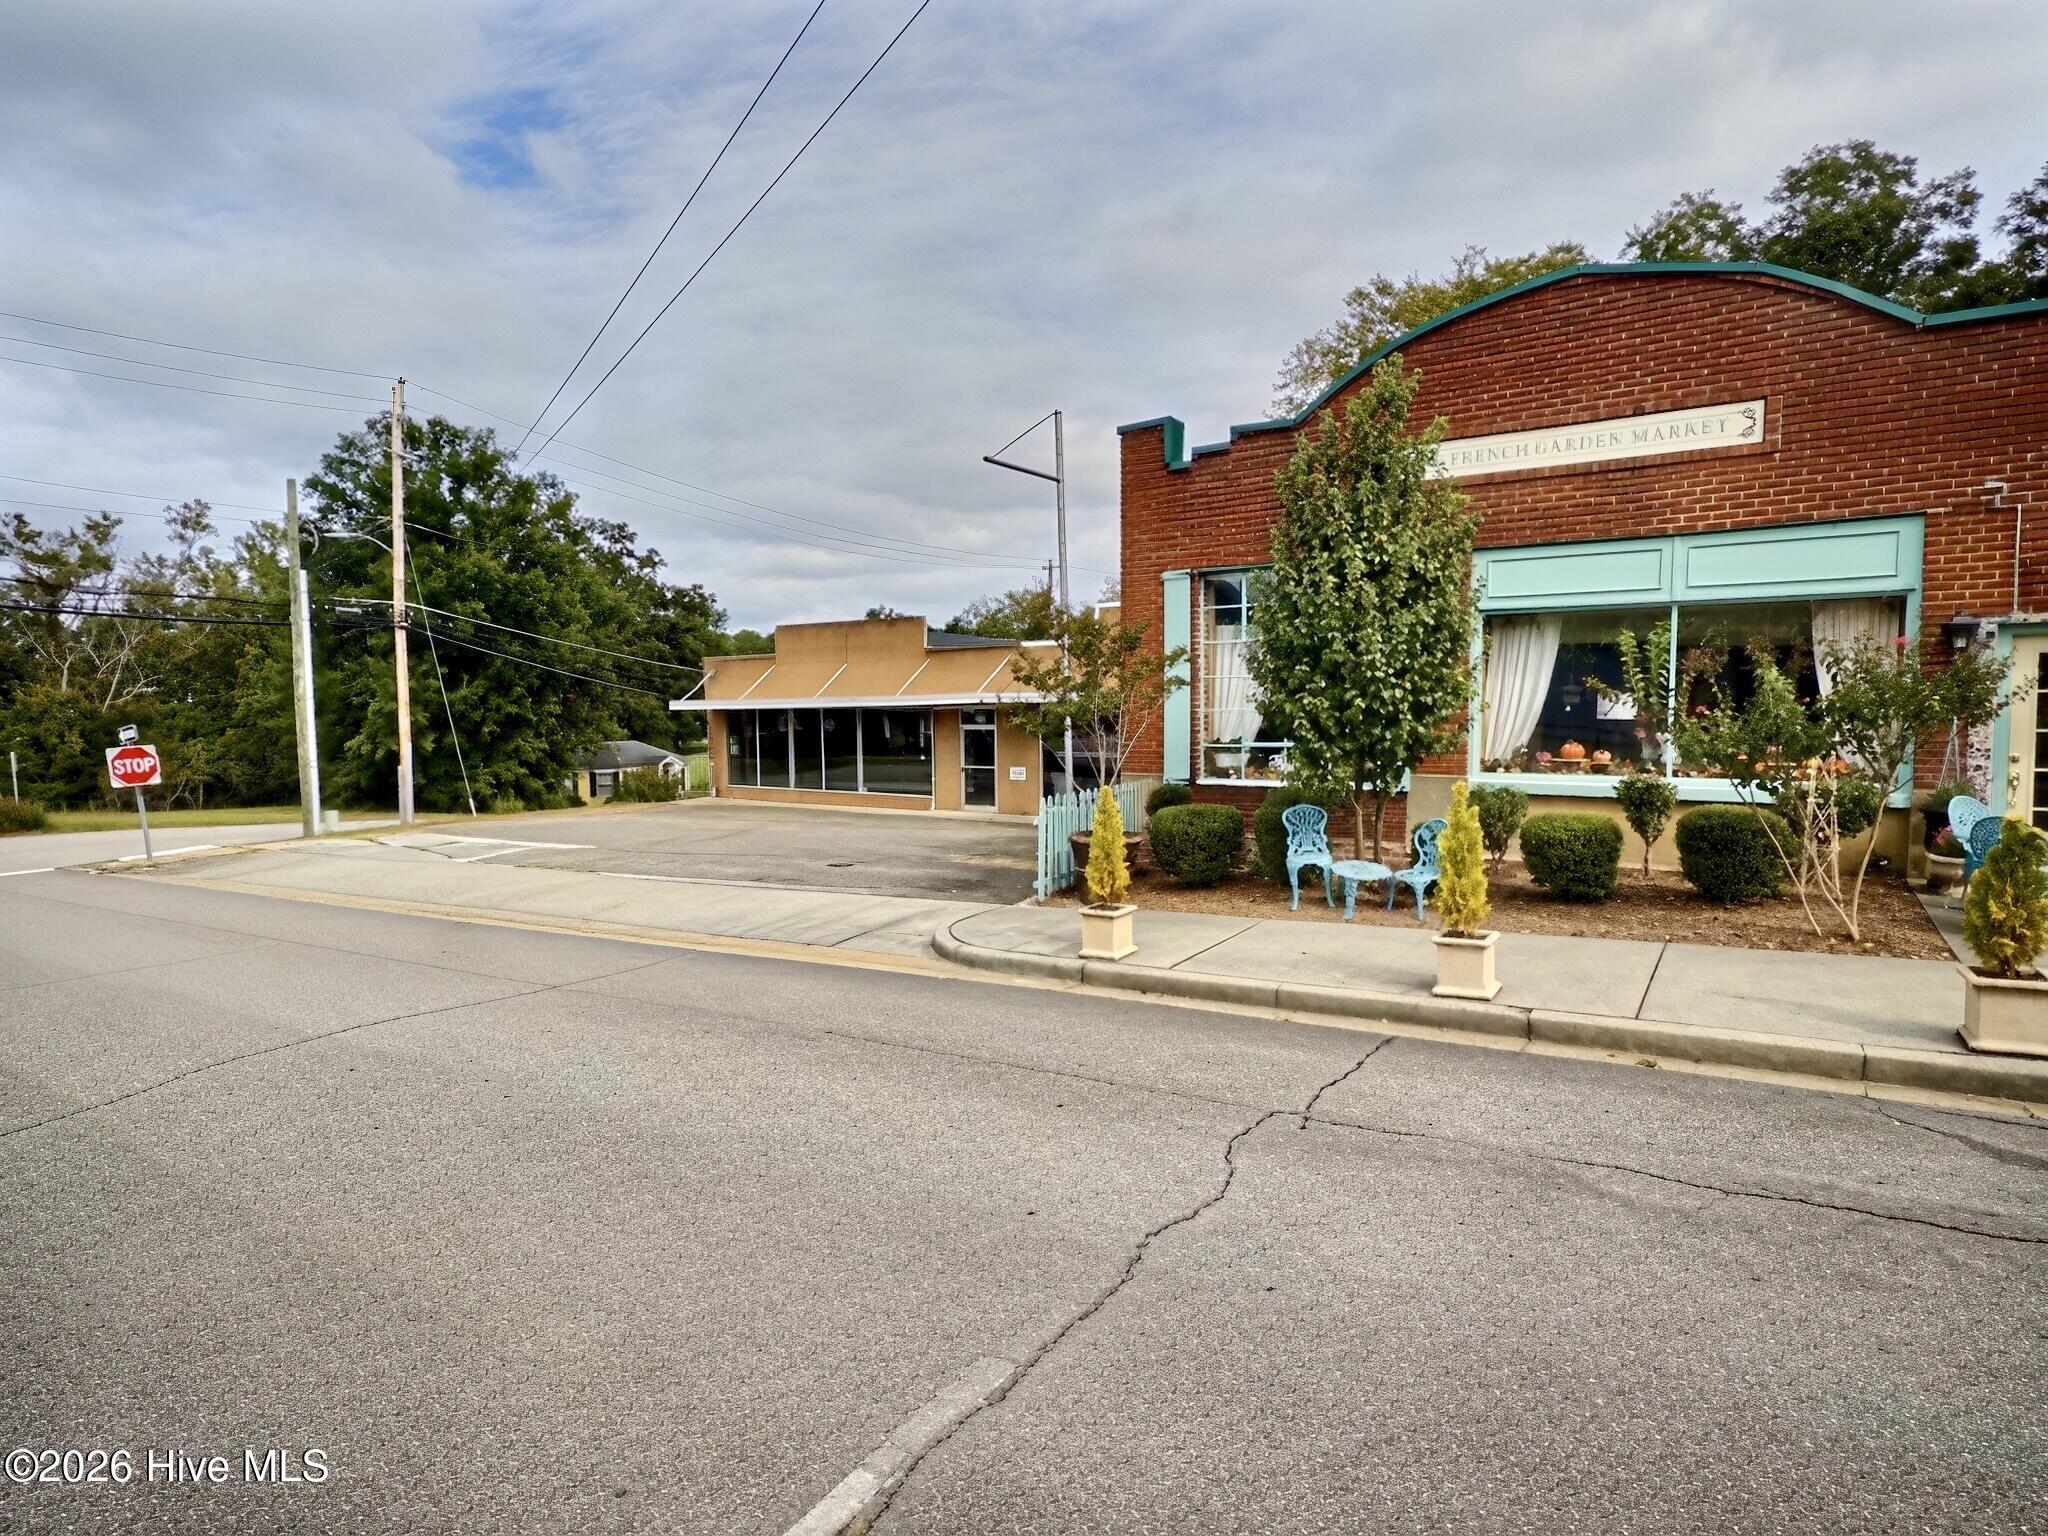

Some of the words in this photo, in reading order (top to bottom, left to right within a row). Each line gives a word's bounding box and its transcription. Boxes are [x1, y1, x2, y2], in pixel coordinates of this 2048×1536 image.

[1451, 443, 1529, 466] FRENCH
[1535, 431, 1622, 455] GARDEN
[1632, 416, 1729, 444] MARKET
[113, 757, 156, 775] STOP
